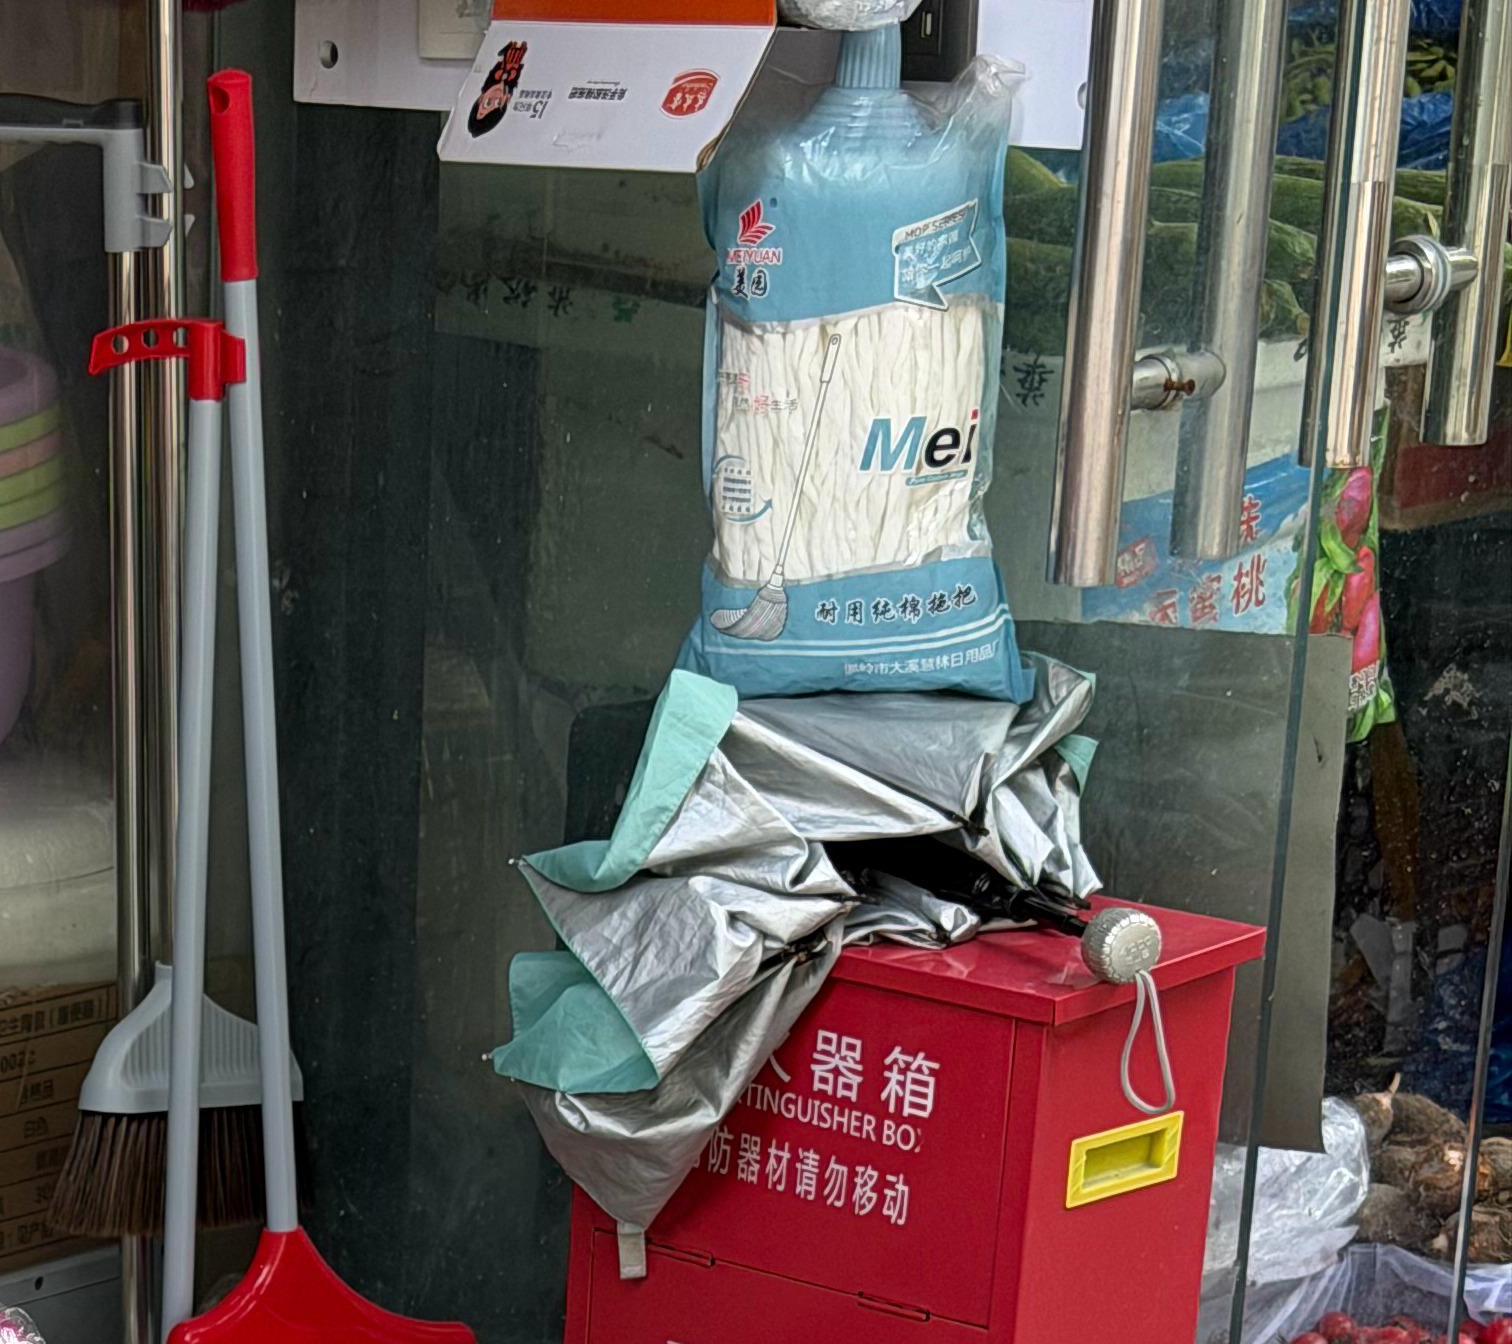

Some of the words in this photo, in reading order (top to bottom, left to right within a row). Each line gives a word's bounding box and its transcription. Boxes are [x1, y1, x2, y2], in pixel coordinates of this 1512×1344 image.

[858, 409, 979, 472] Mei
[816, 585, 978, 624] 耐用纯棉拖把
[769, 1028, 941, 1119] 器箱
[740, 1083, 877, 1143] TINGUISHER
[693, 1125, 910, 1226] 防器材请勿移动
